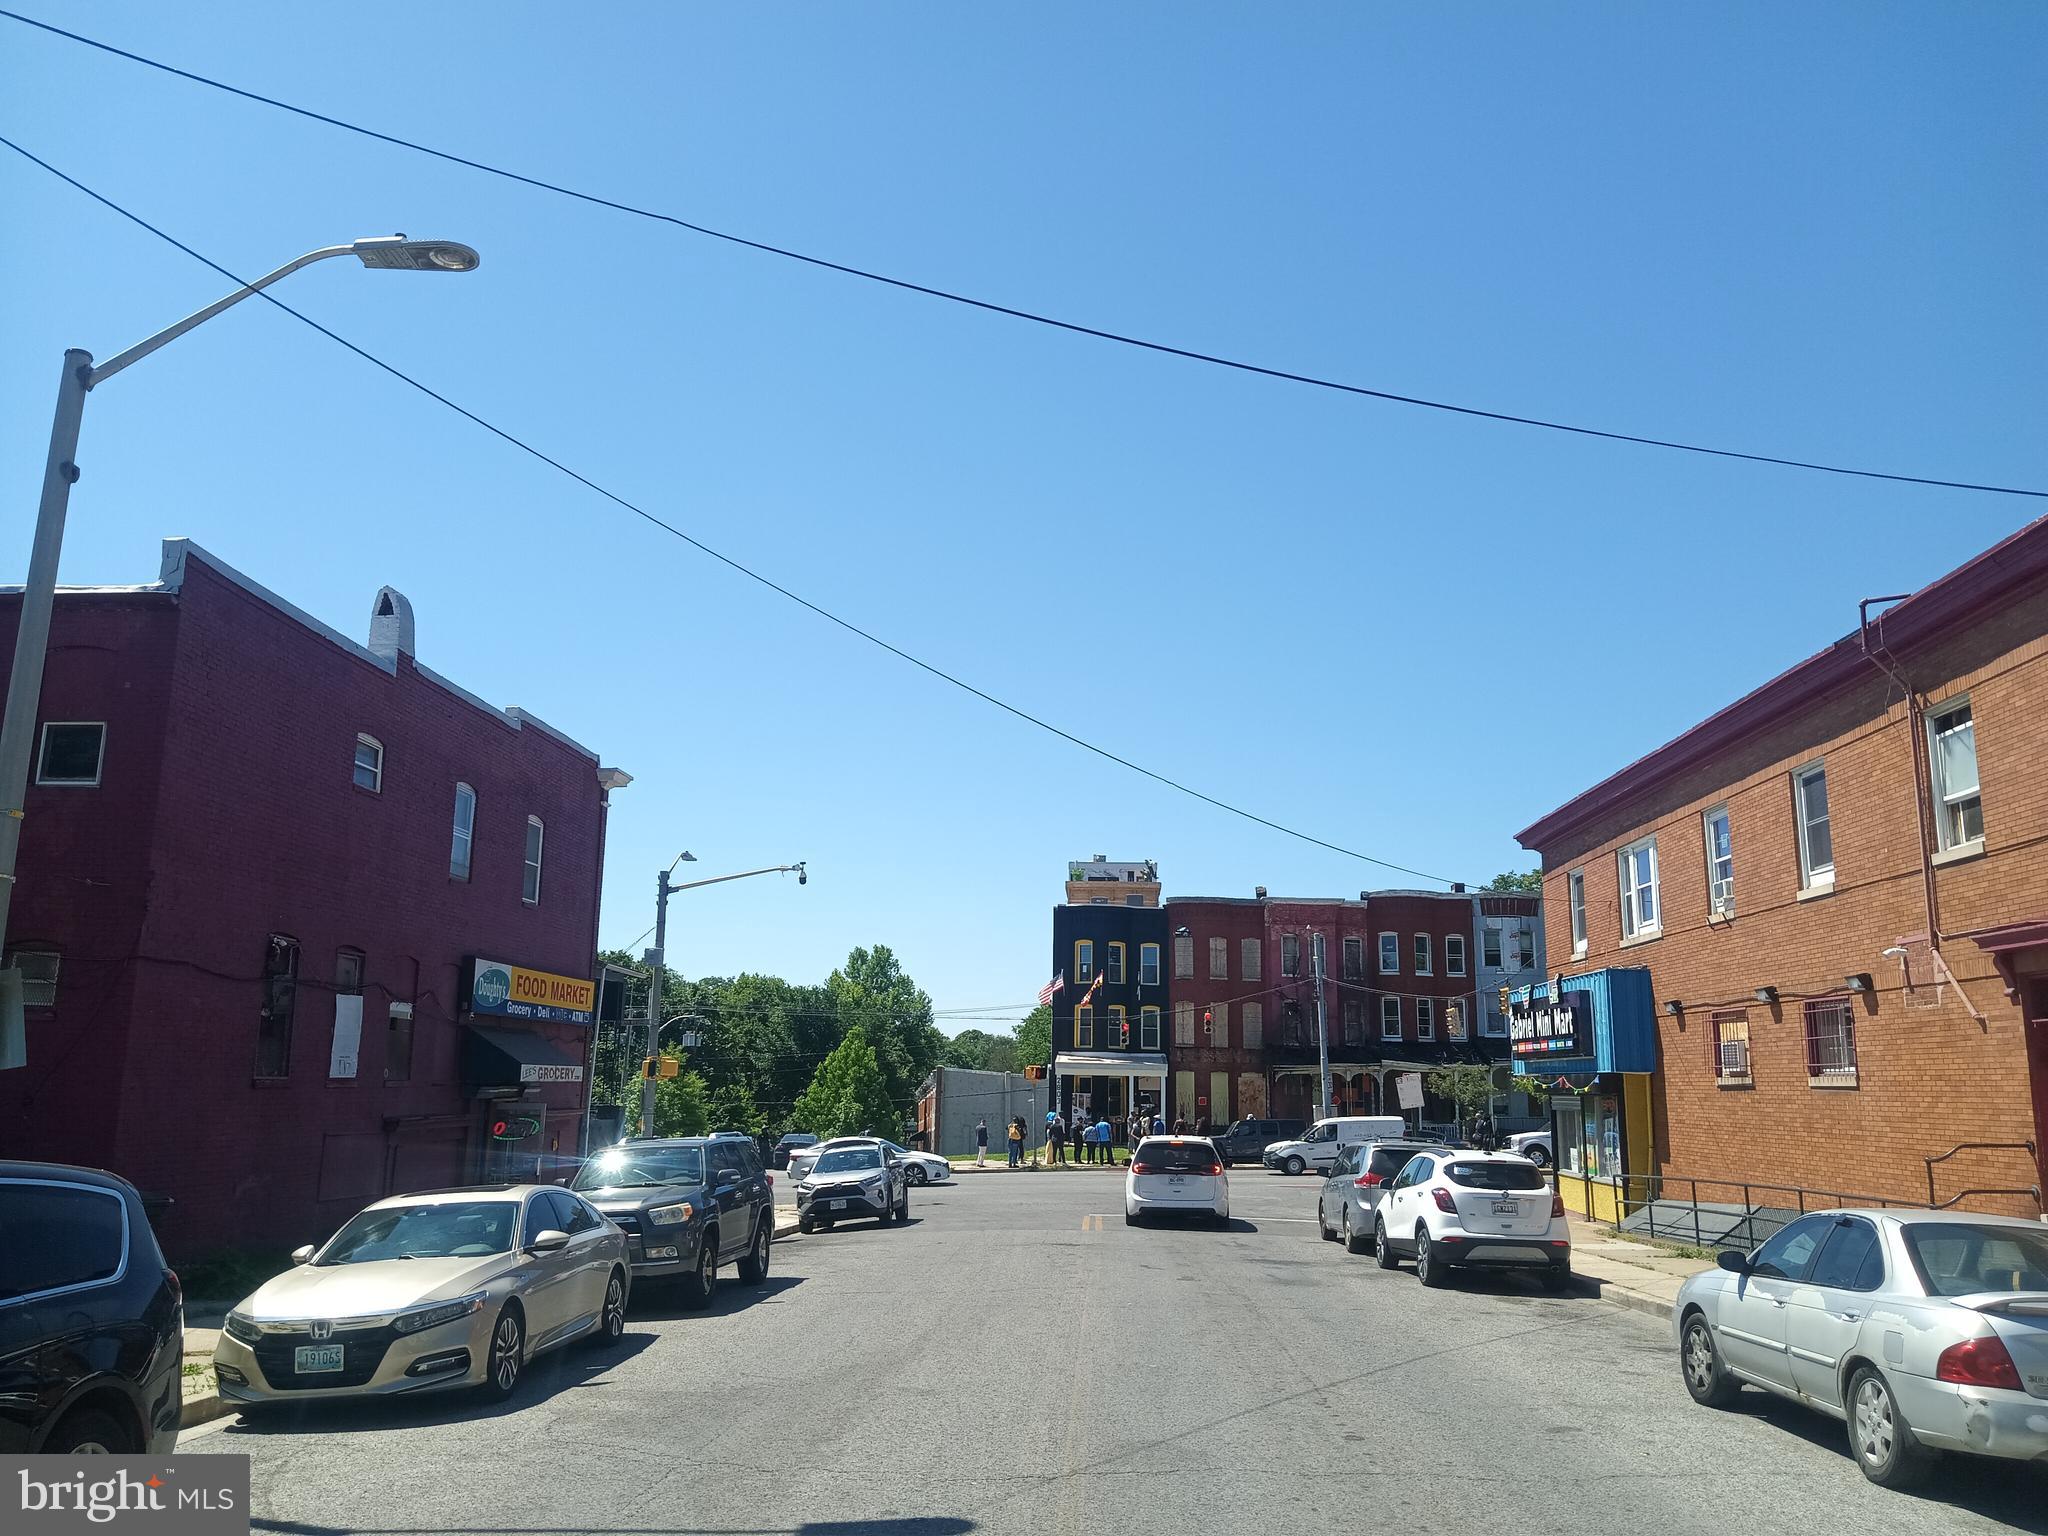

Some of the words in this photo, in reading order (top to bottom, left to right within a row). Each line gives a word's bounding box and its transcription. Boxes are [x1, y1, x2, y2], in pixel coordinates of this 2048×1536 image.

[516, 975, 547, 998] FOOD
[550, 981, 591, 1005] MARKET
[507, 1001, 532, 1018] Grocery
[537, 1006, 550, 1018] Deli
[1509, 1011, 1535, 1040] Gabriel
[1536, 1009, 1552, 1037] Mini
[1554, 1007, 1574, 1035] Mart
[537, 1067, 575, 1080] GROCERY
